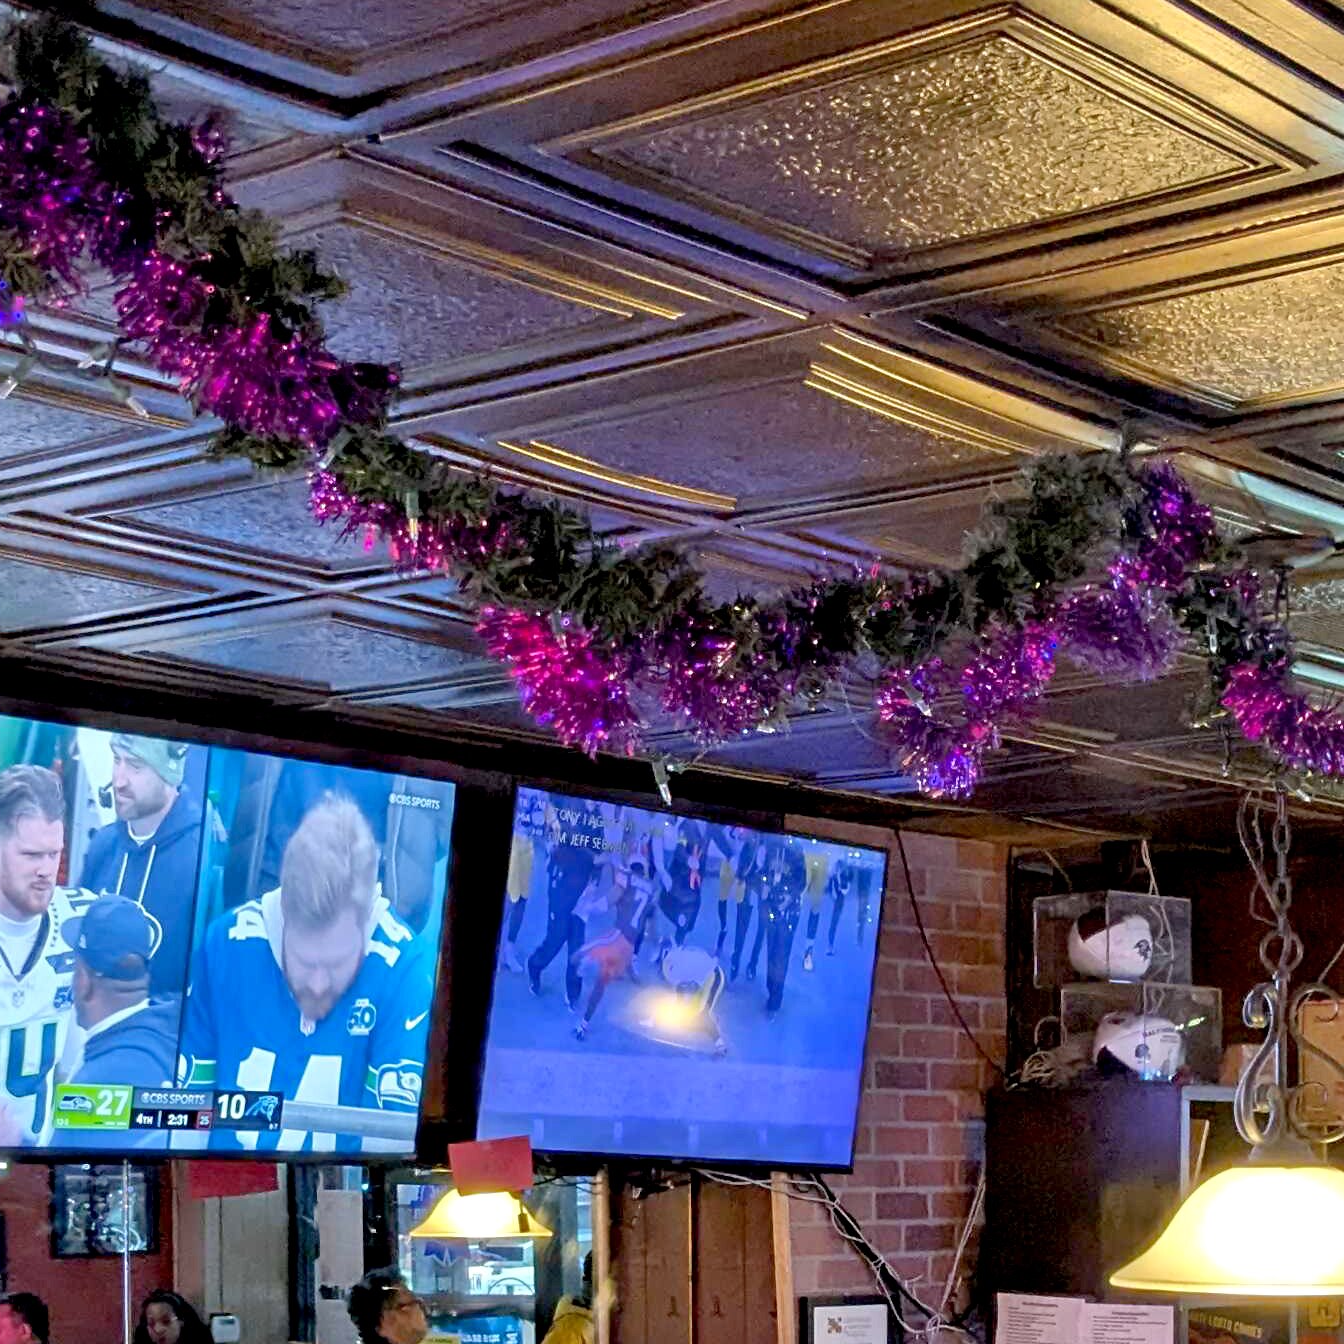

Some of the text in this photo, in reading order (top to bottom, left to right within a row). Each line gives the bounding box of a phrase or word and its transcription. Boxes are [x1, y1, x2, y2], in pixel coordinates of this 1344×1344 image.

[96, 1085, 130, 1117] 27
[169, 1093, 206, 1106] SPORTS
[217, 1094, 246, 1120] 10
[135, 1113, 154, 1126] 4TH
[166, 1113, 189, 1126] 2:31
